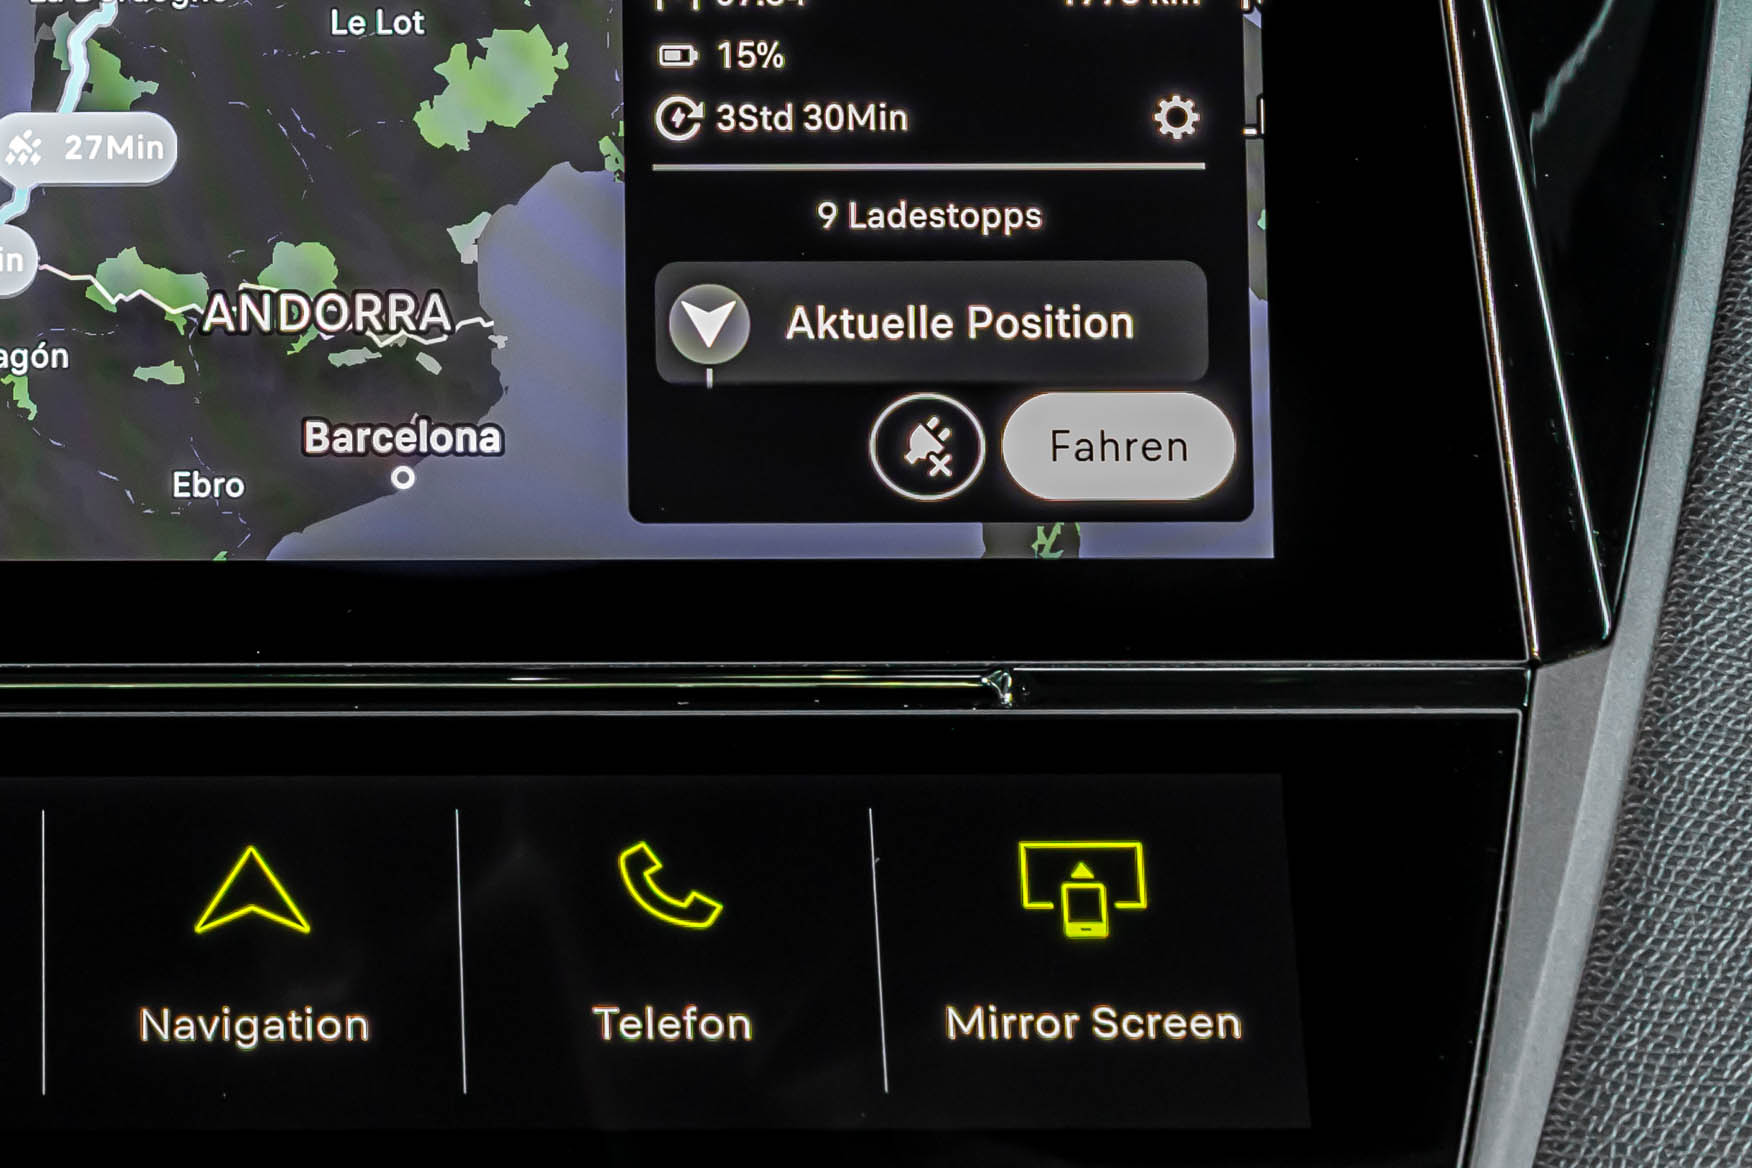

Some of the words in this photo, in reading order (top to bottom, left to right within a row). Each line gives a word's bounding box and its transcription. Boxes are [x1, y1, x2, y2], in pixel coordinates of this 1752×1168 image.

[331, 9, 368, 35] Le
[377, 9, 425, 35] Lot
[718, 40, 786, 70] 15%
[716, 102, 794, 132] 3Std
[804, 102, 909, 132] 30Min
[64, 135, 164, 161] 27Min
[817, 200, 838, 229] 9
[849, 200, 1042, 236] Ladestopps
[202, 292, 452, 333] ANDORRA
[785, 303, 954, 340] Aktuelle
[968, 303, 1135, 340] Position
[303, 419, 503, 455] Barcelona
[1050, 429, 1189, 463] Fahren
[171, 470, 245, 500] Ebro
[140, 1005, 369, 1050] Navigation
[592, 1005, 752, 1041] Telefon
[946, 1004, 1080, 1040] Mirror
[1091, 1004, 1242, 1040] Screen
